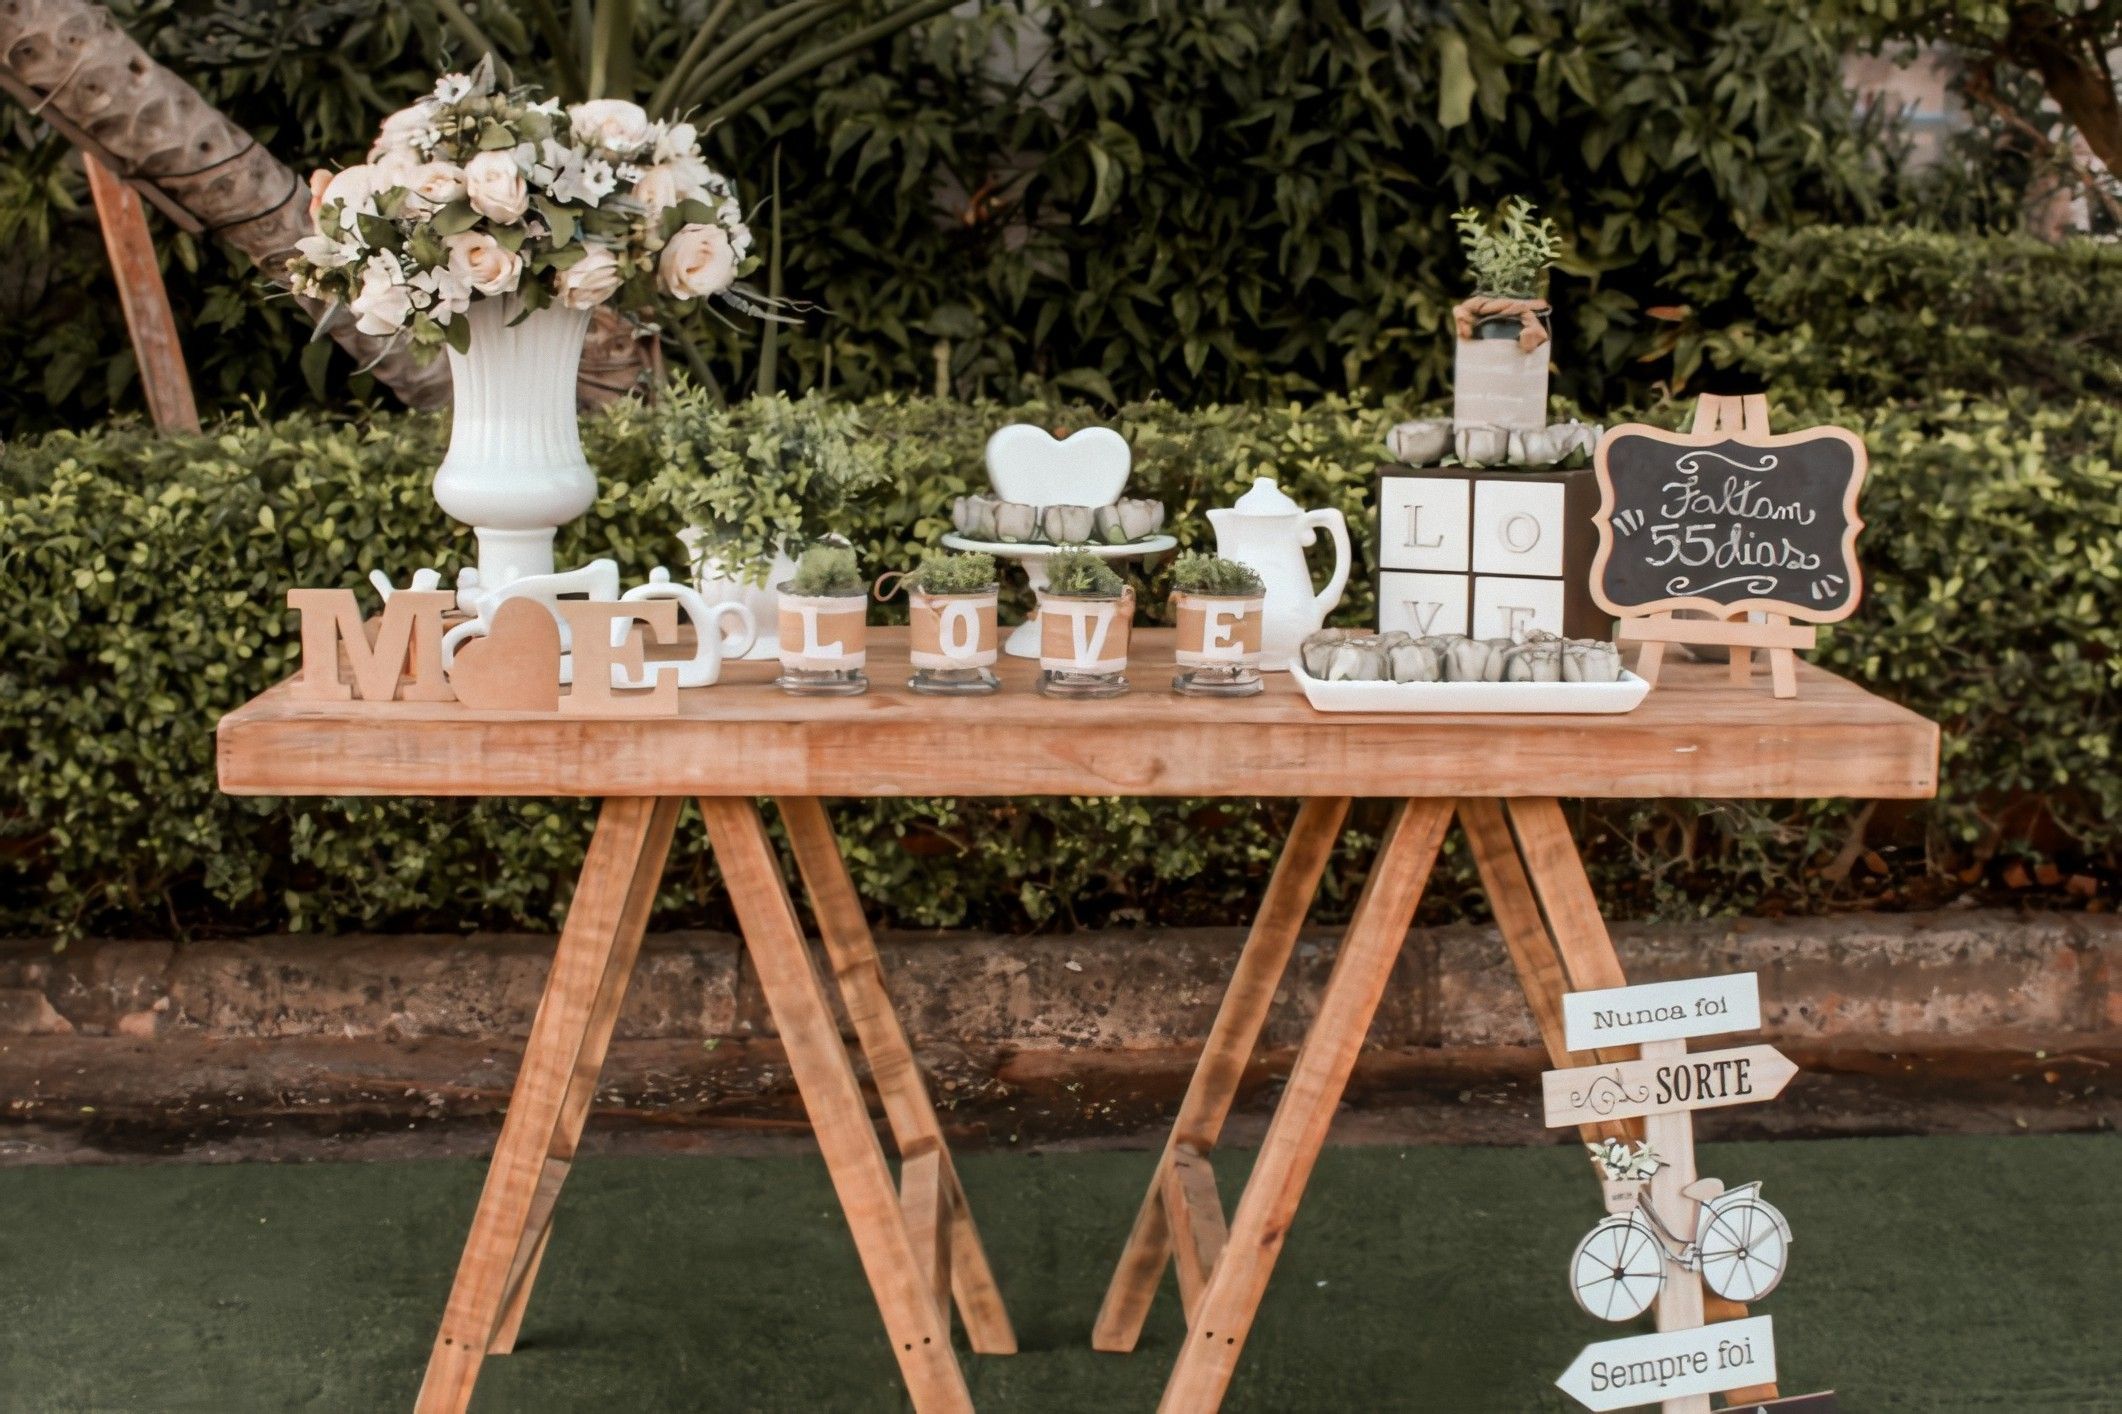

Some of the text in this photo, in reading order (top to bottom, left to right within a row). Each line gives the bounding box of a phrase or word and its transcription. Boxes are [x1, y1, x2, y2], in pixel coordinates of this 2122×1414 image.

[1661, 474, 1816, 527] Faltam
[1645, 523, 1820, 570] 55 dias
[1593, 995, 1728, 1030] Nunca foi
[1656, 1058, 1752, 1104] SORTE
[1590, 1337, 1755, 1392] Sempre foi
